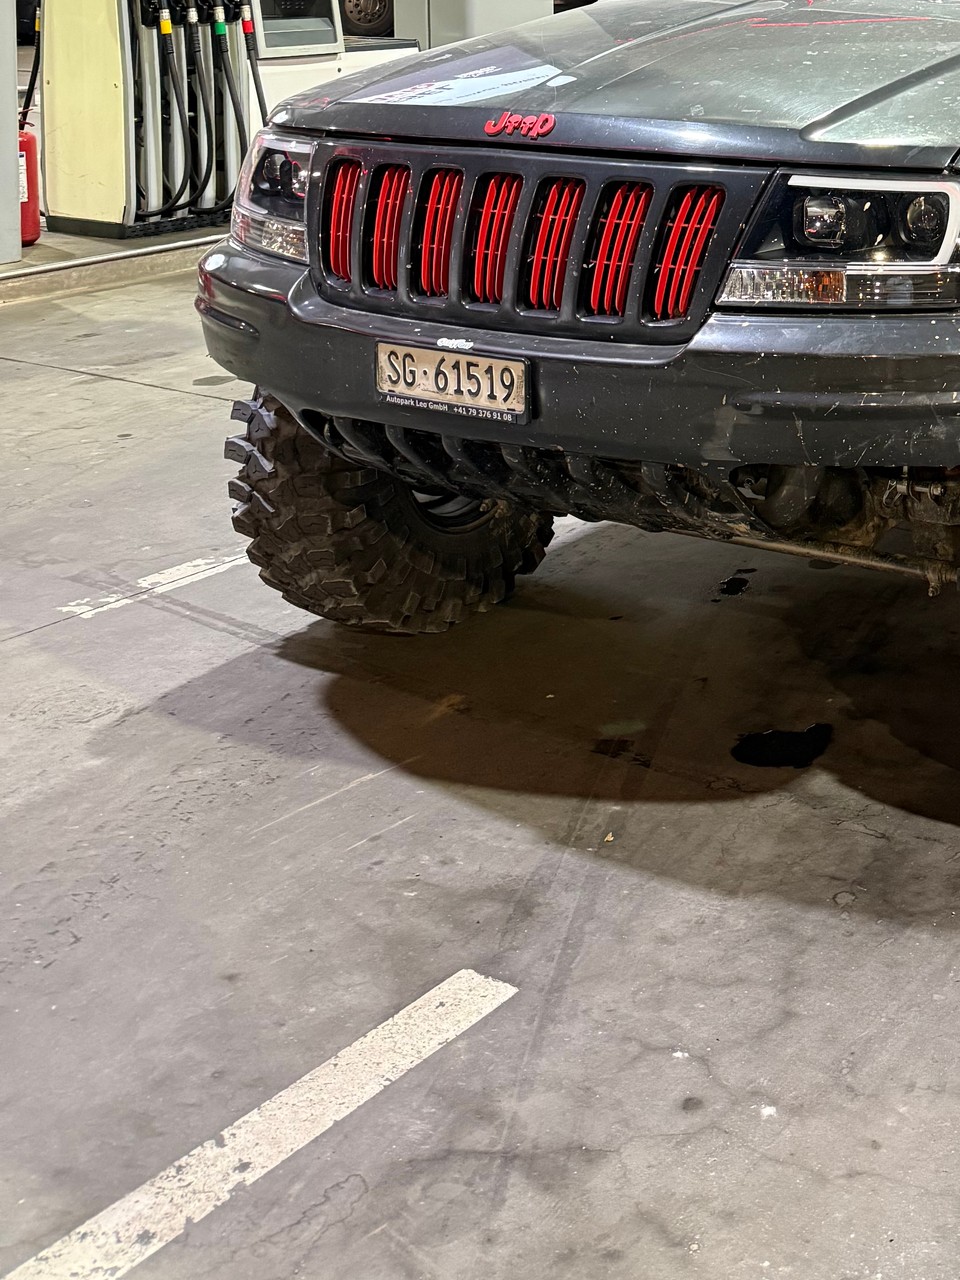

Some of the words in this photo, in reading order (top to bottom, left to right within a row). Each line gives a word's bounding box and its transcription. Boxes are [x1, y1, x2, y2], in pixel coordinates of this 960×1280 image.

[484, 111, 556, 140] Jeep
[386, 394, 415, 407] Autopark
[428, 401, 448, 412] GmbH
[453, 406, 466, 415] +41
[468, 407, 477, 416] 79
[478, 409, 491, 419] 376
[492, 411, 502, 420] 91
